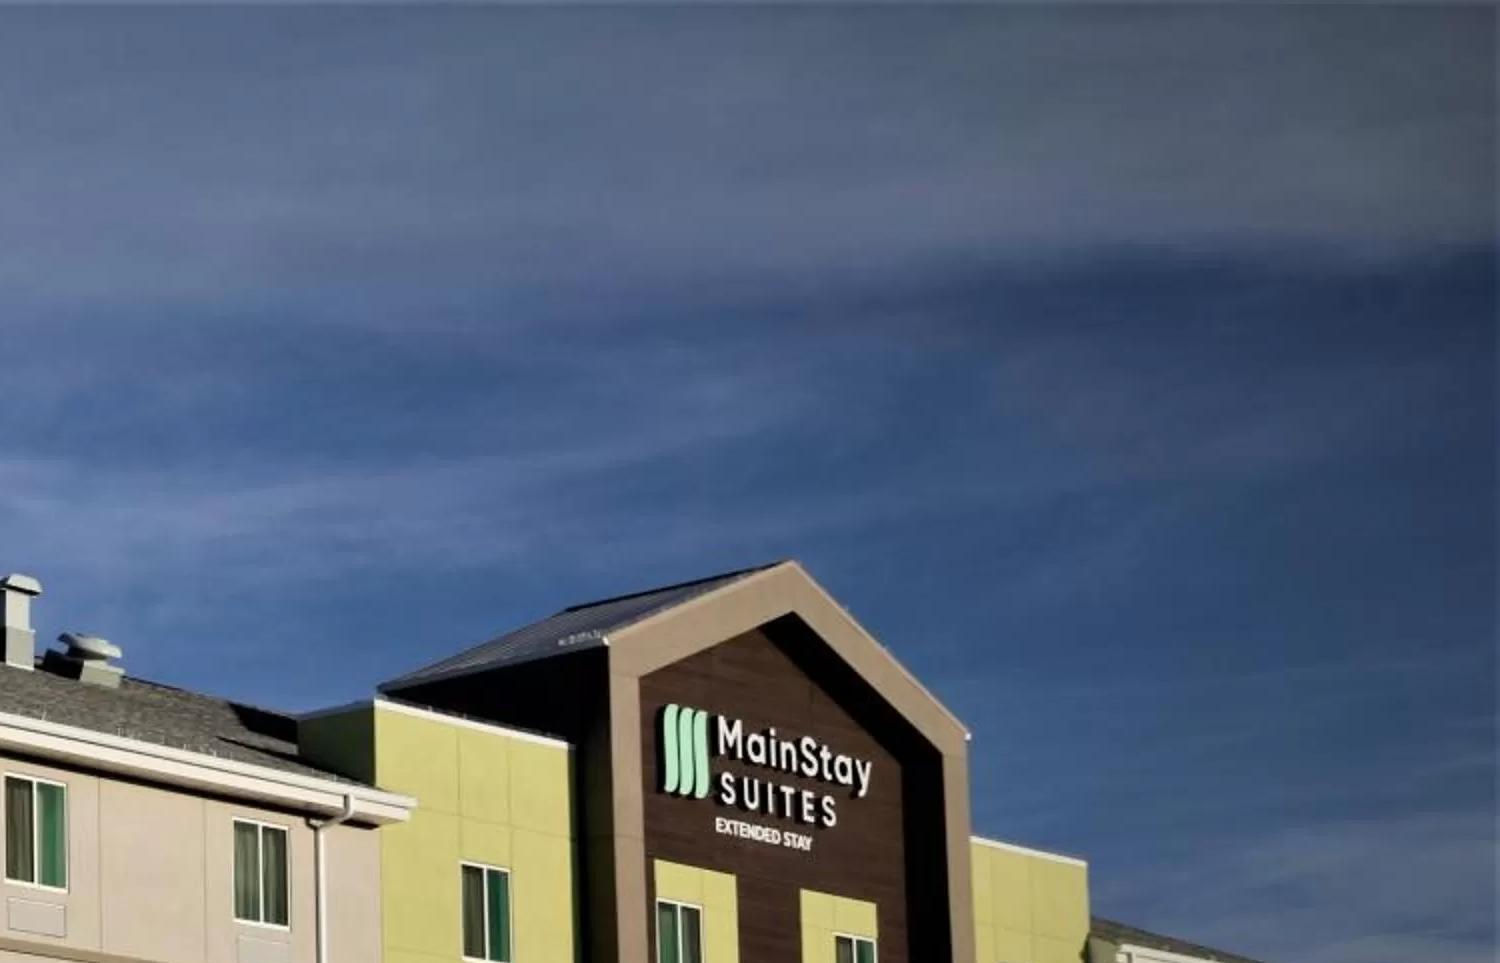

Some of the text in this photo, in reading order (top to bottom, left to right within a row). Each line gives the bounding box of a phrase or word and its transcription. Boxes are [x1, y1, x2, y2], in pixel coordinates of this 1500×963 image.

[717, 714, 873, 798] MainStay
[720, 771, 838, 828] SUITES
[714, 816, 814, 851] EXTENDED STAY
